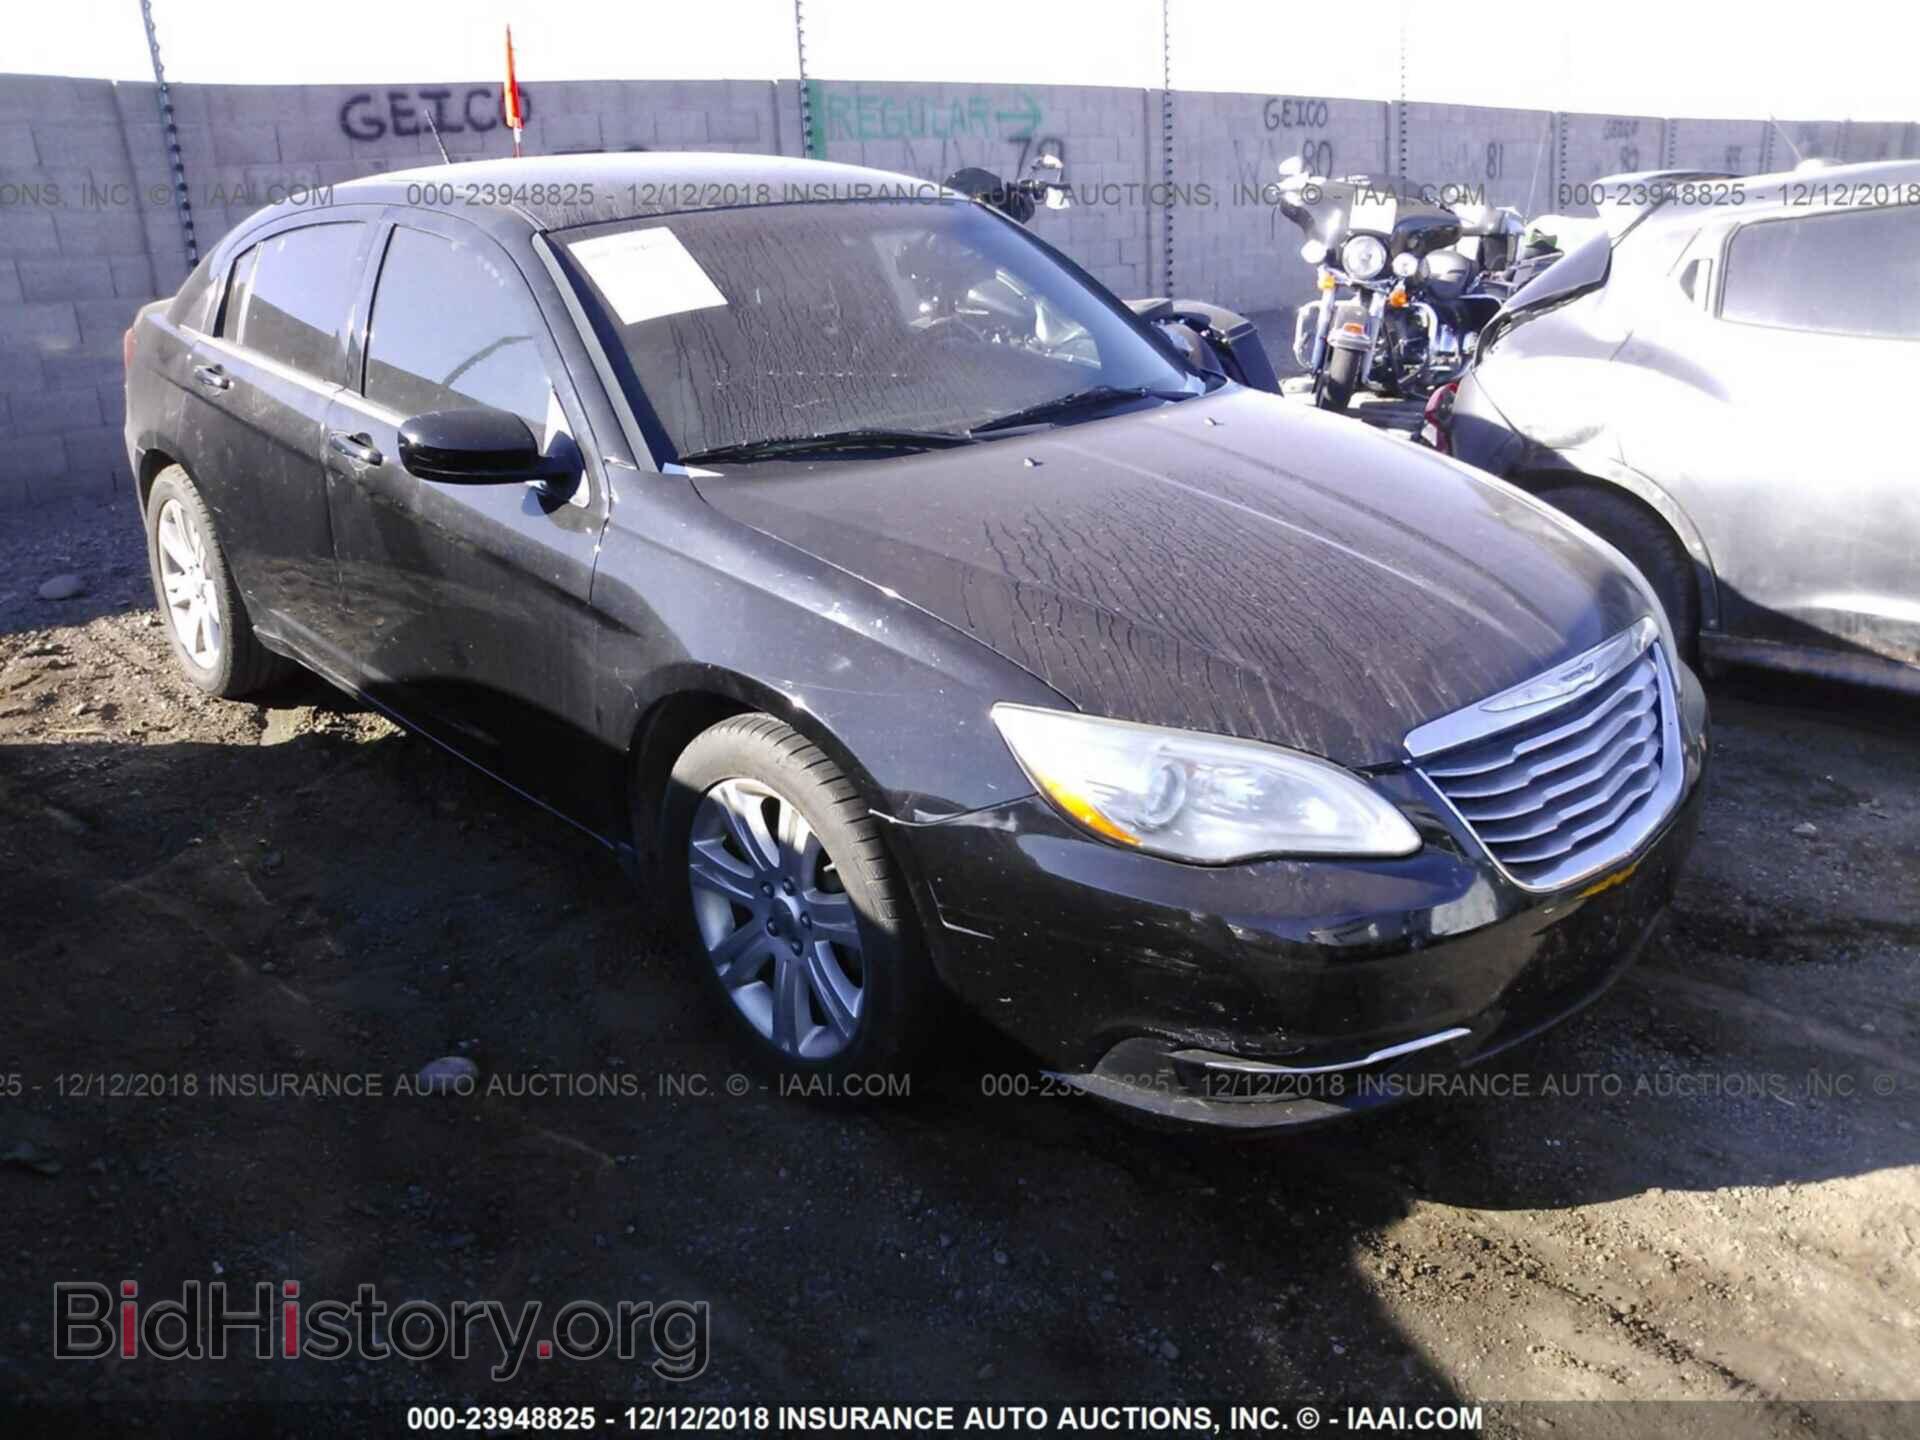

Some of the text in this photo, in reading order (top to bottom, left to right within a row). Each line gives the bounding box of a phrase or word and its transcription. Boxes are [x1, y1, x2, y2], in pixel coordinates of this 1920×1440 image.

[339, 88, 532, 142] GEICO
[826, 94, 992, 142] REGULAR
[1263, 98, 1329, 131] GEICO
